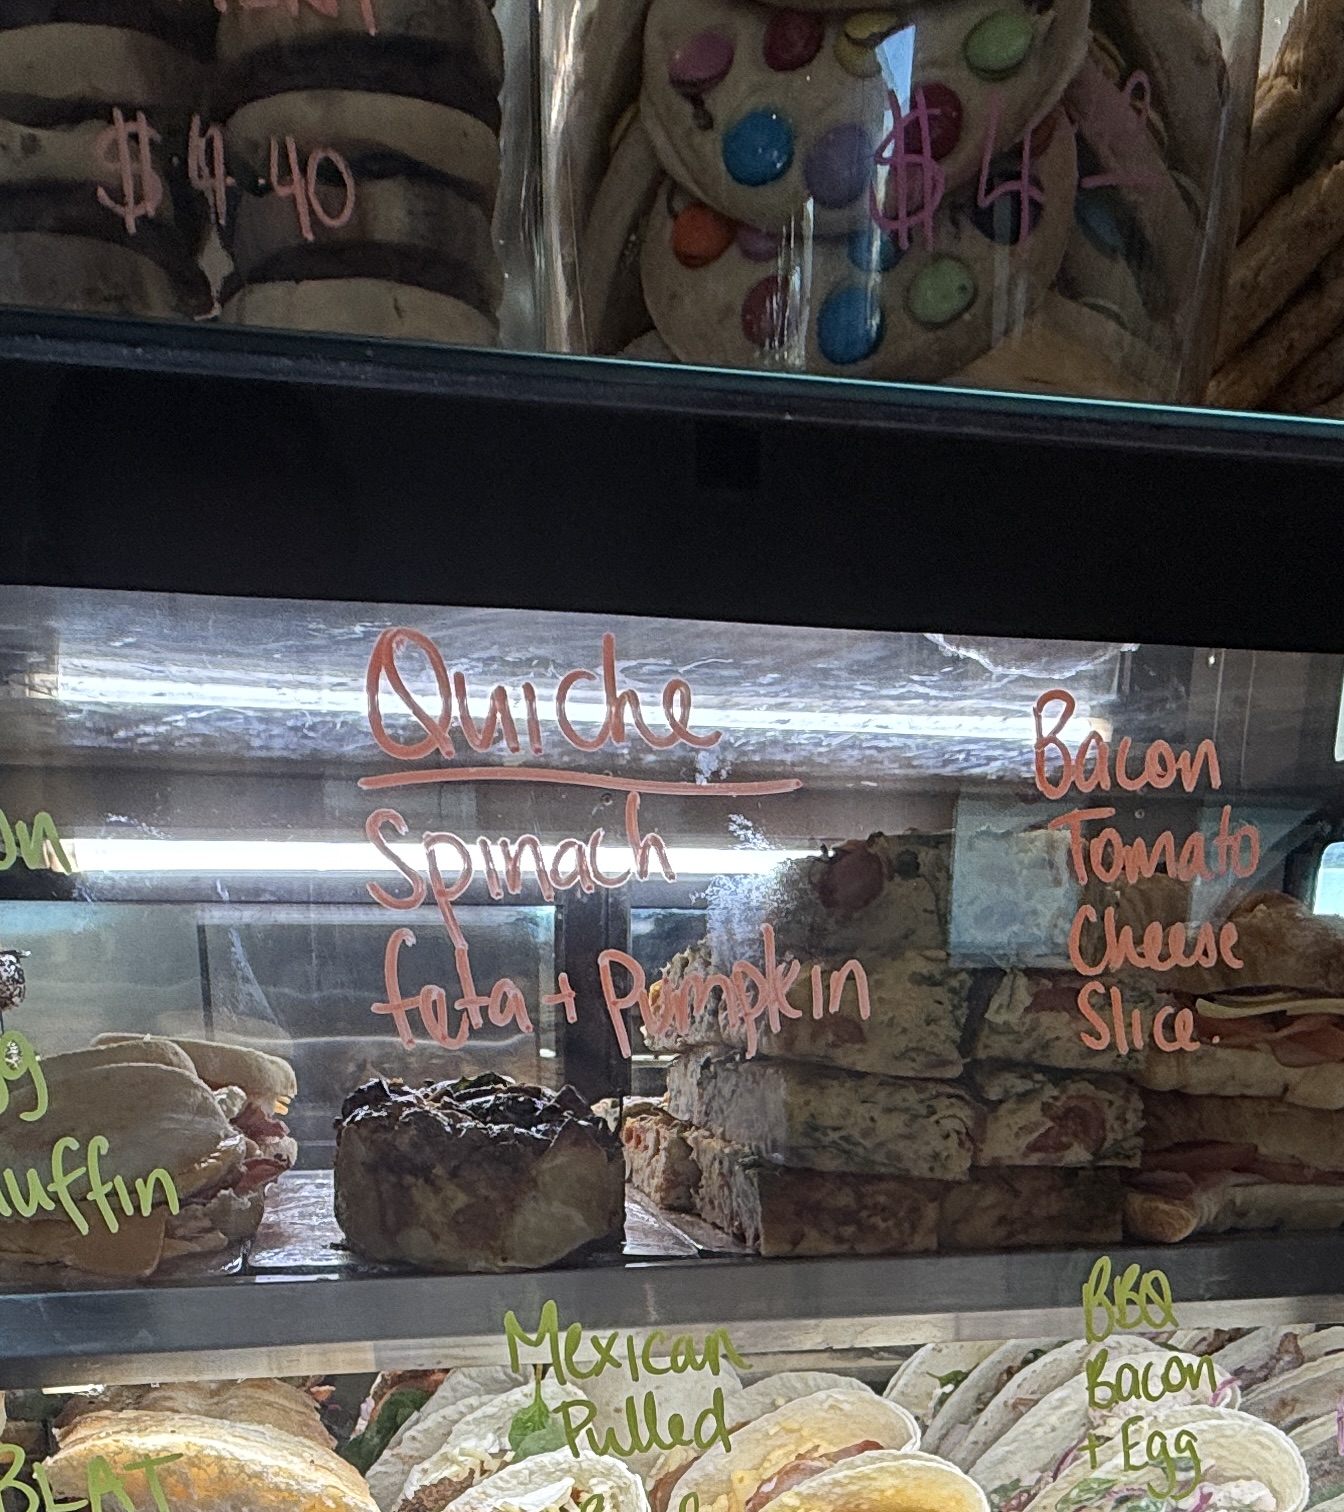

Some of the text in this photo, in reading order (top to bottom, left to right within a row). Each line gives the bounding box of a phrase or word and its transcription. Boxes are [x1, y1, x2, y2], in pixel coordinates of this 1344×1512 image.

[365, 626, 723, 761] Quiche
[1032, 689, 1222, 799] Bacon
[365, 791, 678, 950] Spinach
[1049, 804, 1262, 885] Tomato
[1069, 904, 1245, 977] Cheese
[370, 927, 534, 1050] feta
[597, 922, 871, 1059] Pumpkin
[503, 1298, 754, 1387] Mexican
[1081, 1255, 1181, 1344] BBQ
[552, 1388, 734, 1459] Pulled
[1085, 1353, 1218, 1411] Bacon
[1119, 1413, 1203, 1500] Egg
